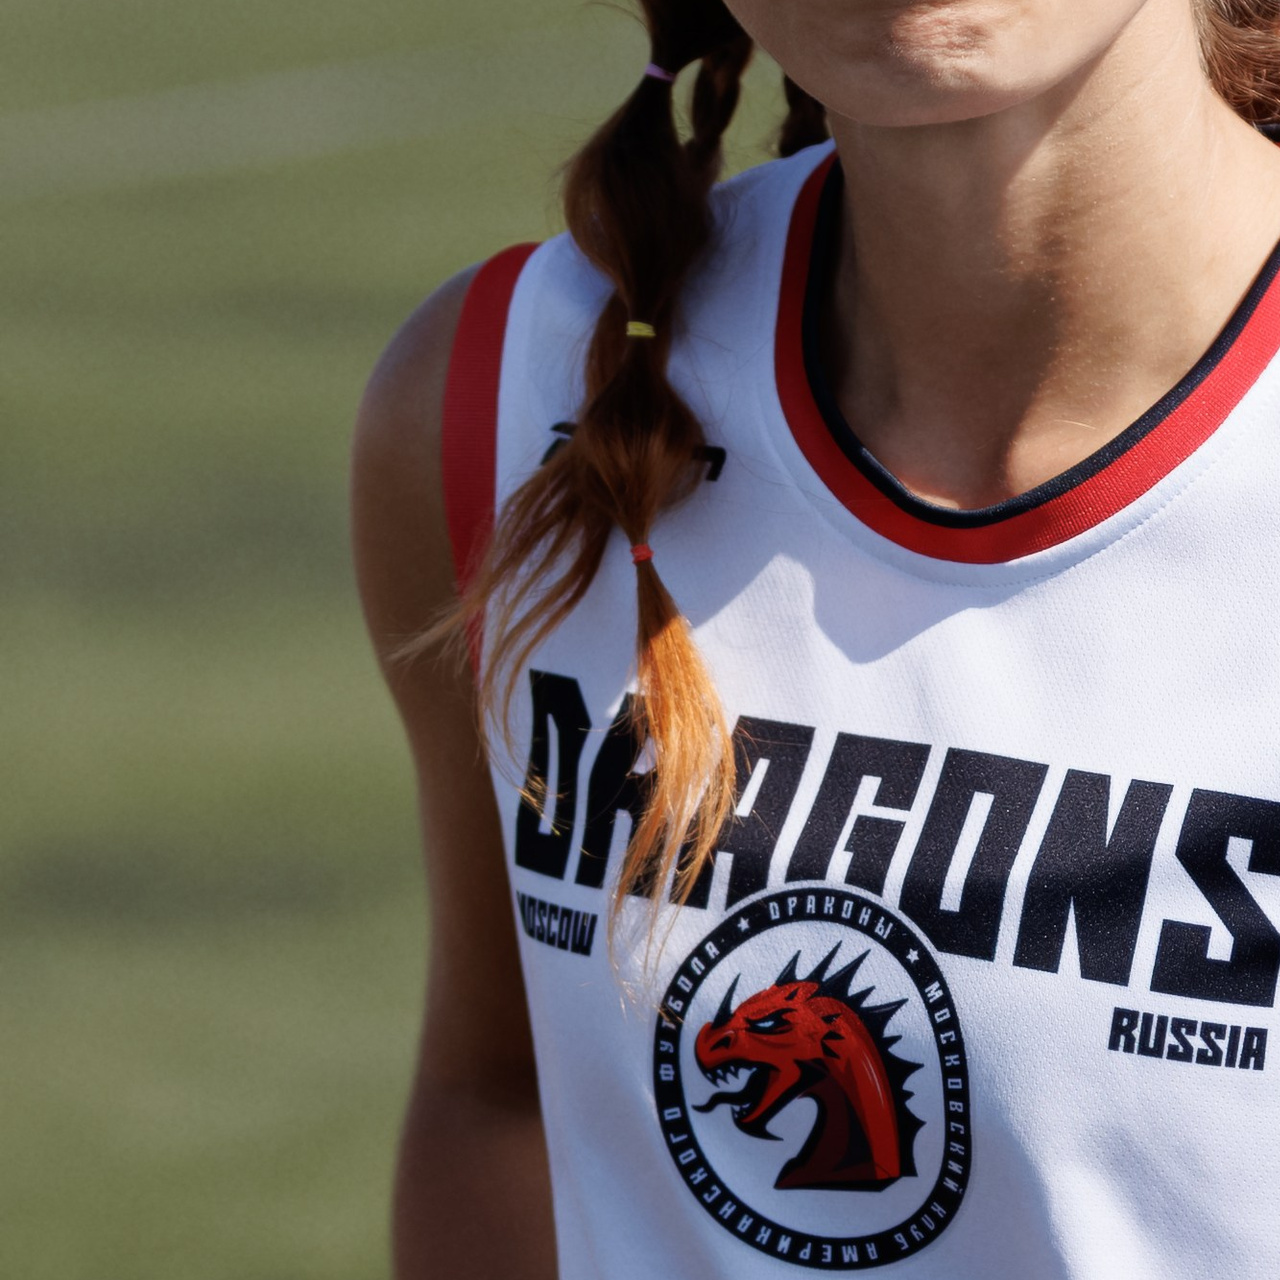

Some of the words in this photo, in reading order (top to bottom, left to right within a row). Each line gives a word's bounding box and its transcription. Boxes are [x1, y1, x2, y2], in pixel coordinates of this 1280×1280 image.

[769, 894, 894, 940] ДРАКОНЫ
[659, 940, 721, 1081] ФУТБОЛА
[1108, 1006, 1269, 1071] RUSSIA
[924, 981, 965, 1195] МОСКОВСКИЙ
[663, 1106, 879, 1263] АМЕРИКАНСКОГО
[894, 1201, 947, 1251] КЛУБ
